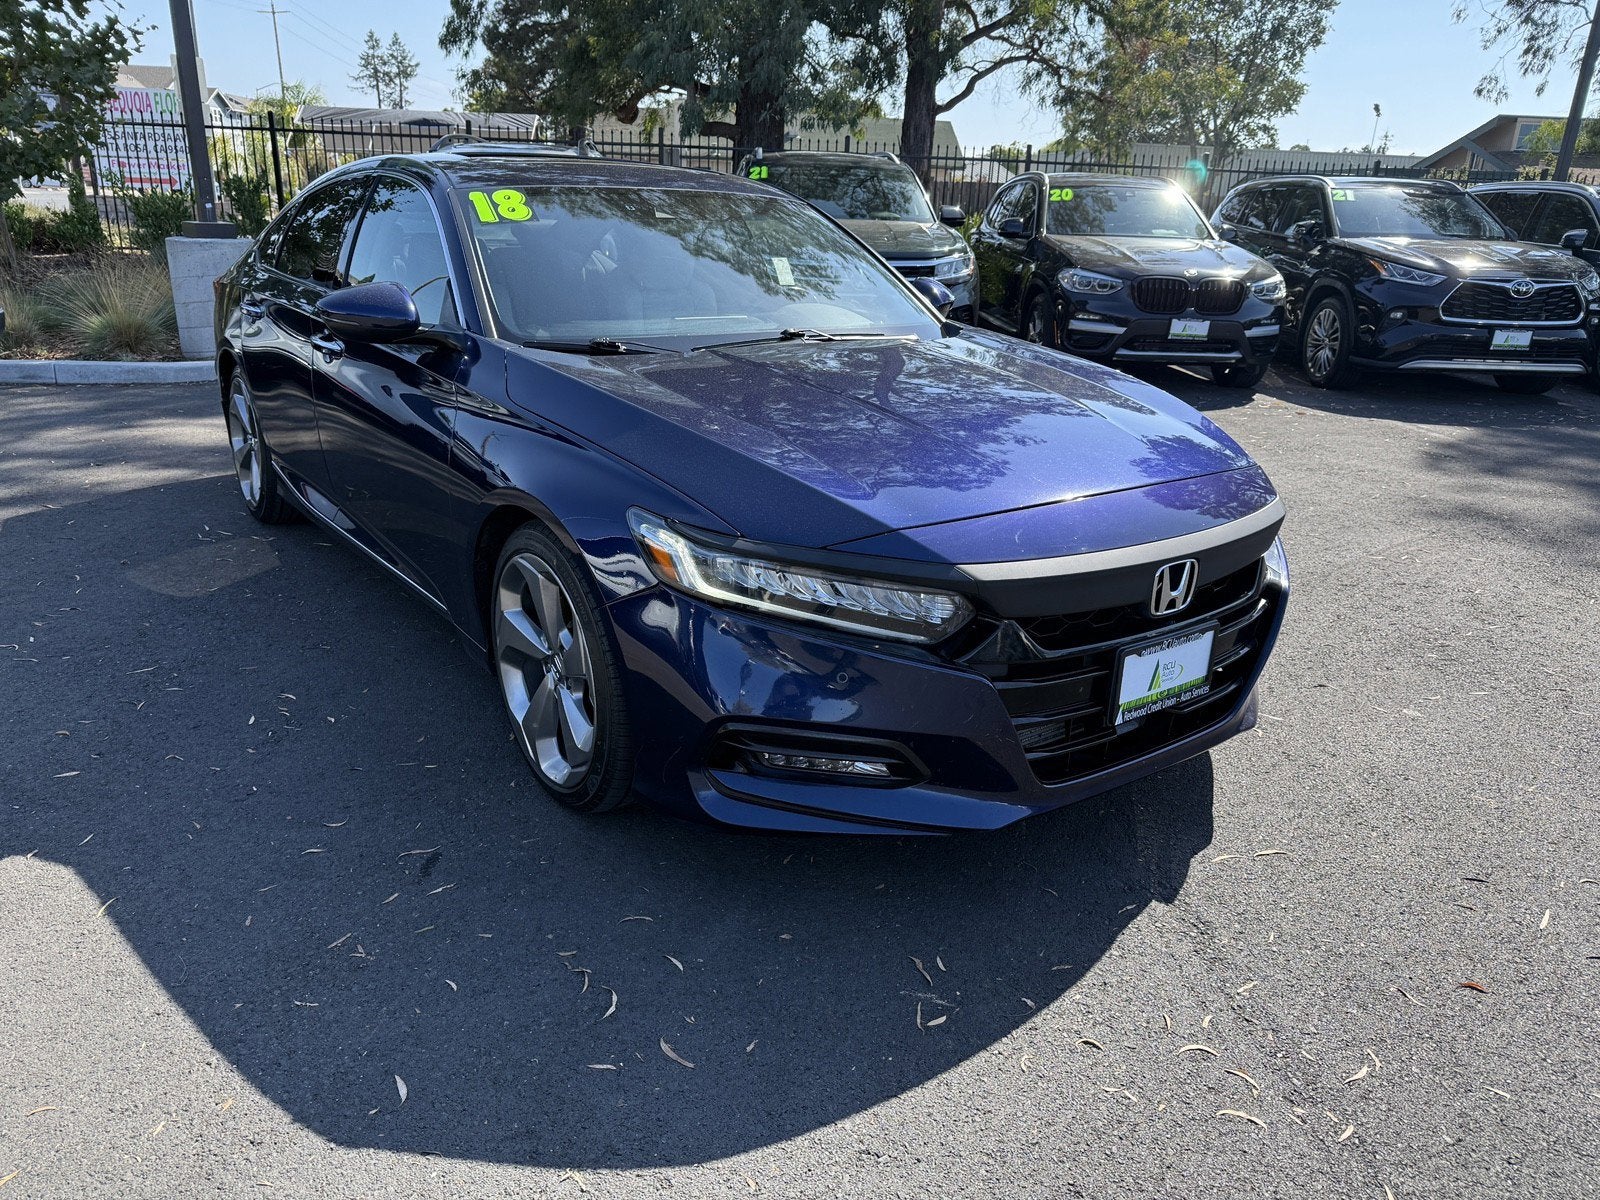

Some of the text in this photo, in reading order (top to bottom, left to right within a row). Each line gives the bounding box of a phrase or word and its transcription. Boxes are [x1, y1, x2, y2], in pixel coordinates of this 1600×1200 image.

[749, 166, 768, 179] 21
[1049, 188, 1073, 201] 20
[1331, 189, 1355, 201] 21
[468, 189, 533, 222] 18
[1123, 705, 1148, 721] Redwood
[1147, 698, 1163, 714] Credit
[1162, 696, 1177, 710] Union
[1180, 690, 1193, 703] Auto
[1192, 685, 1210, 699] Services
